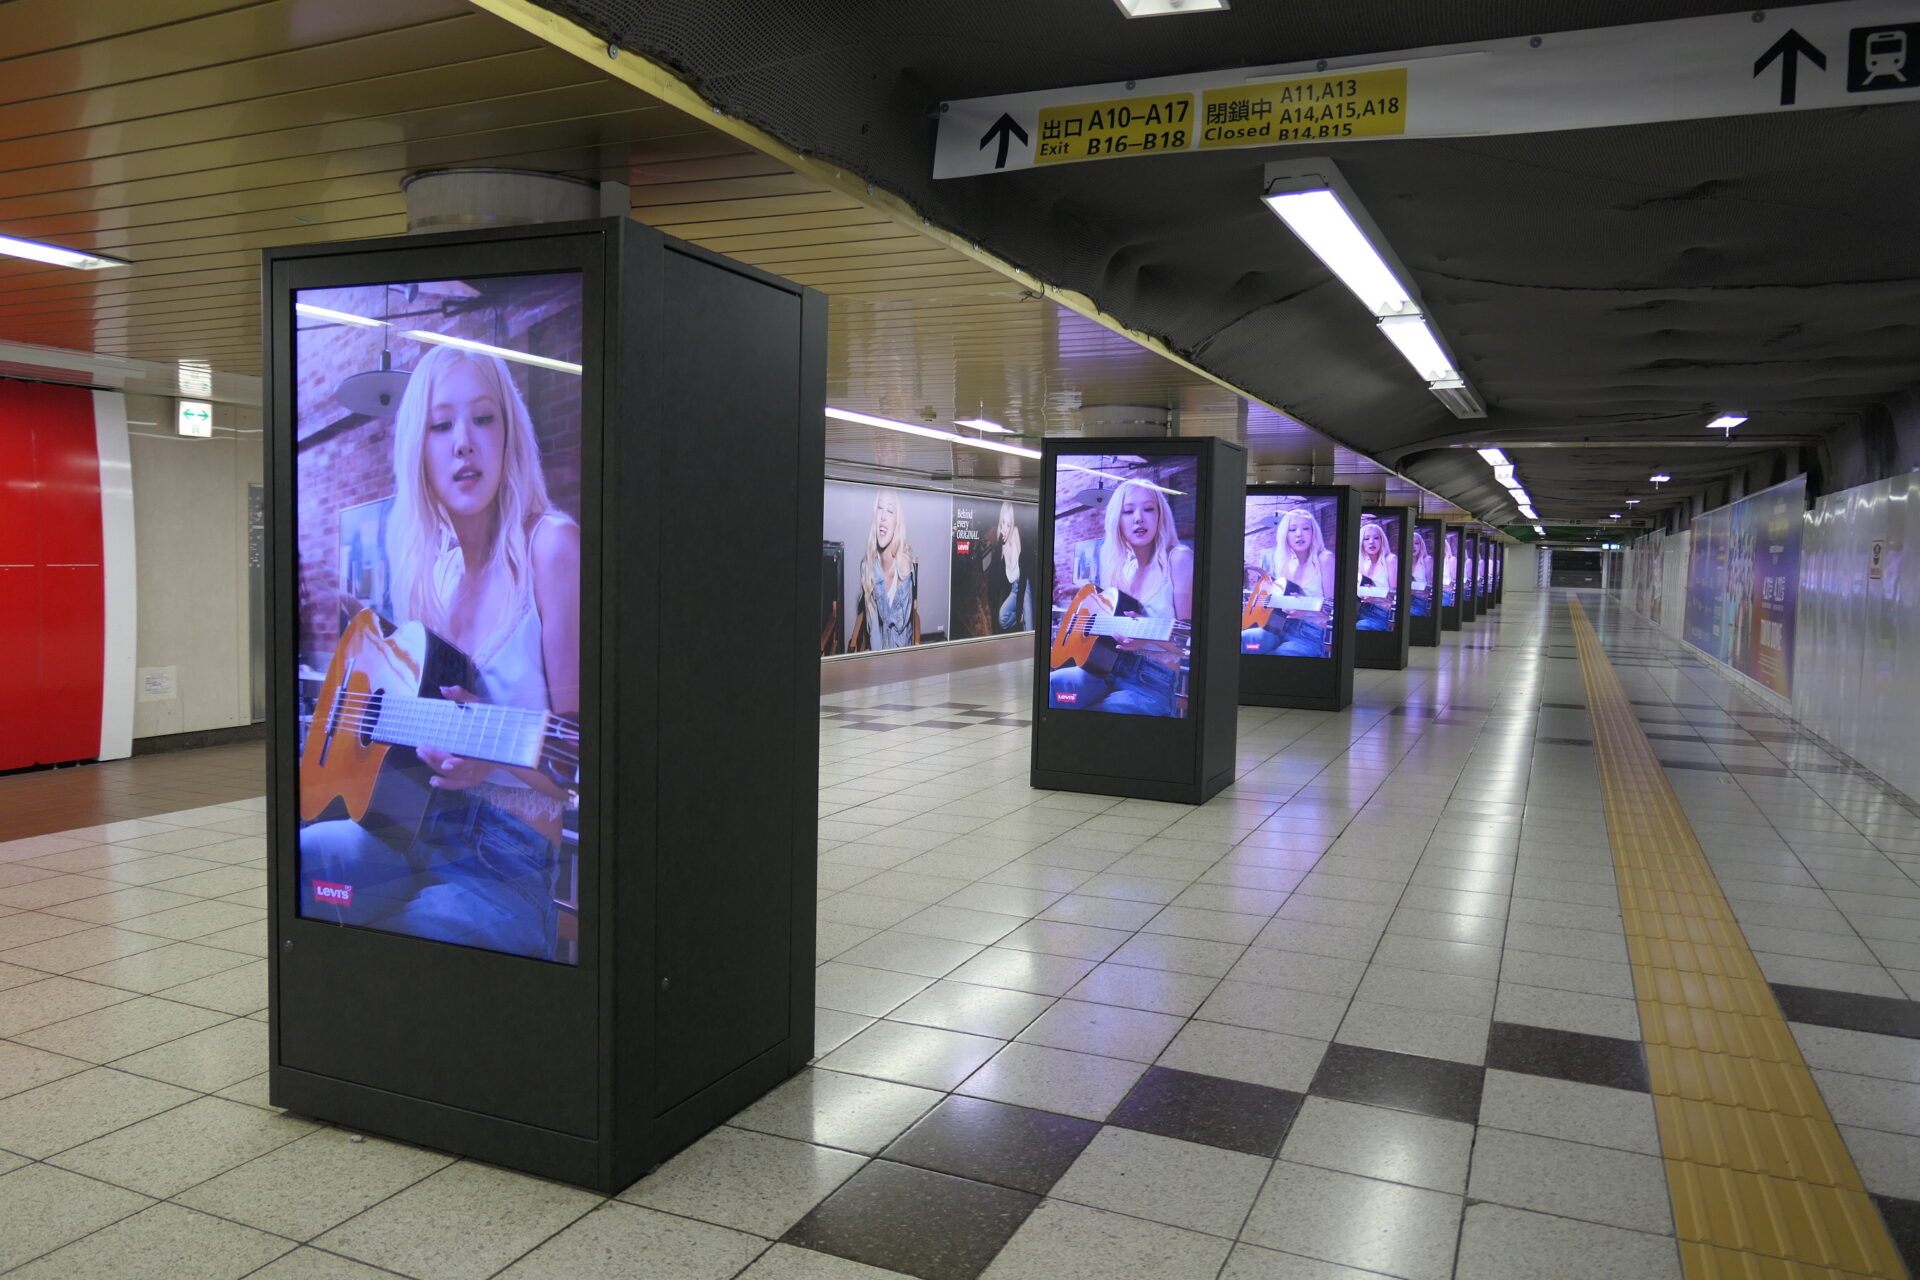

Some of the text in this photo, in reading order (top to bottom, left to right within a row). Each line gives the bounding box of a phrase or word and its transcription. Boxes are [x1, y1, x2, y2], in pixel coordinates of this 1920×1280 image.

[1281, 79, 1357, 103] A11,A13
[1207, 99, 1272, 125] 閉鎖中
[1280, 97, 1399, 124] A14,A15,A18
[1042, 118, 1083, 140] 出口
[1204, 122, 1271, 141] Closed
[1040, 141, 1070, 156] Exit
[957, 509, 973, 519] Behind
[956, 520, 969, 530] every
